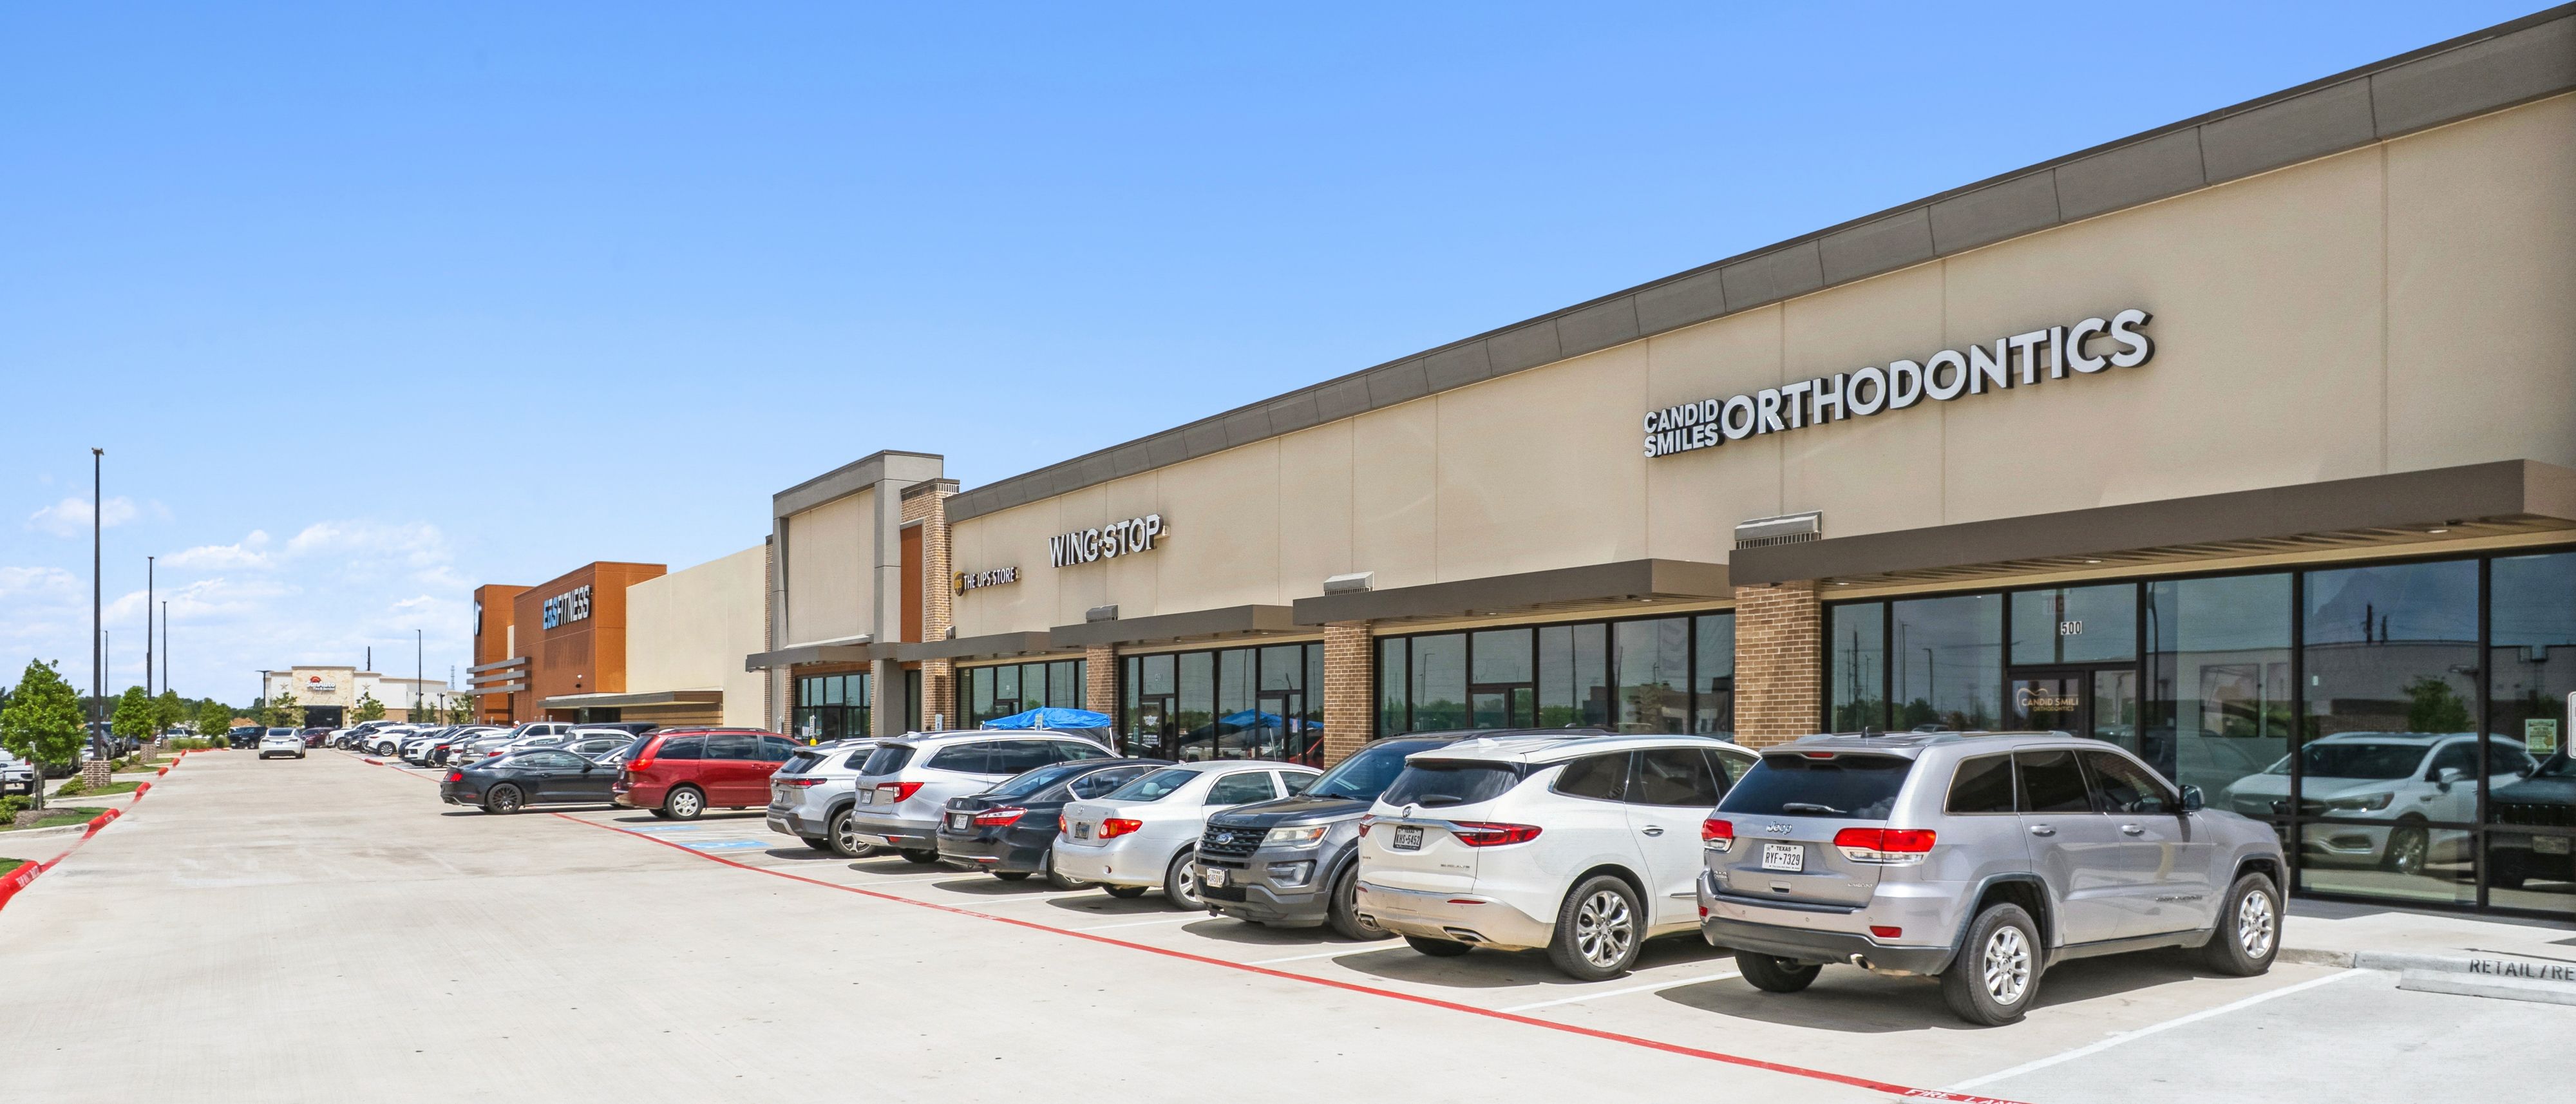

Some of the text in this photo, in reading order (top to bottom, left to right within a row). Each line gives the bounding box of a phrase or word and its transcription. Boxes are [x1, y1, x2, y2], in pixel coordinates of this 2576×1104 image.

[1721, 309, 2152, 440] ORTHODONTICS
[1643, 399, 1719, 434] CANDID
[1643, 424, 1720, 458] SMILES
[963, 567, 1014, 590] THE UPS STORE
[2061, 621, 2081, 634] 500
[2022, 698, 2053, 707] CANDID
[1766, 821, 1793, 835] Jeep
[1904, 1089, 1958, 1100] FIRE
